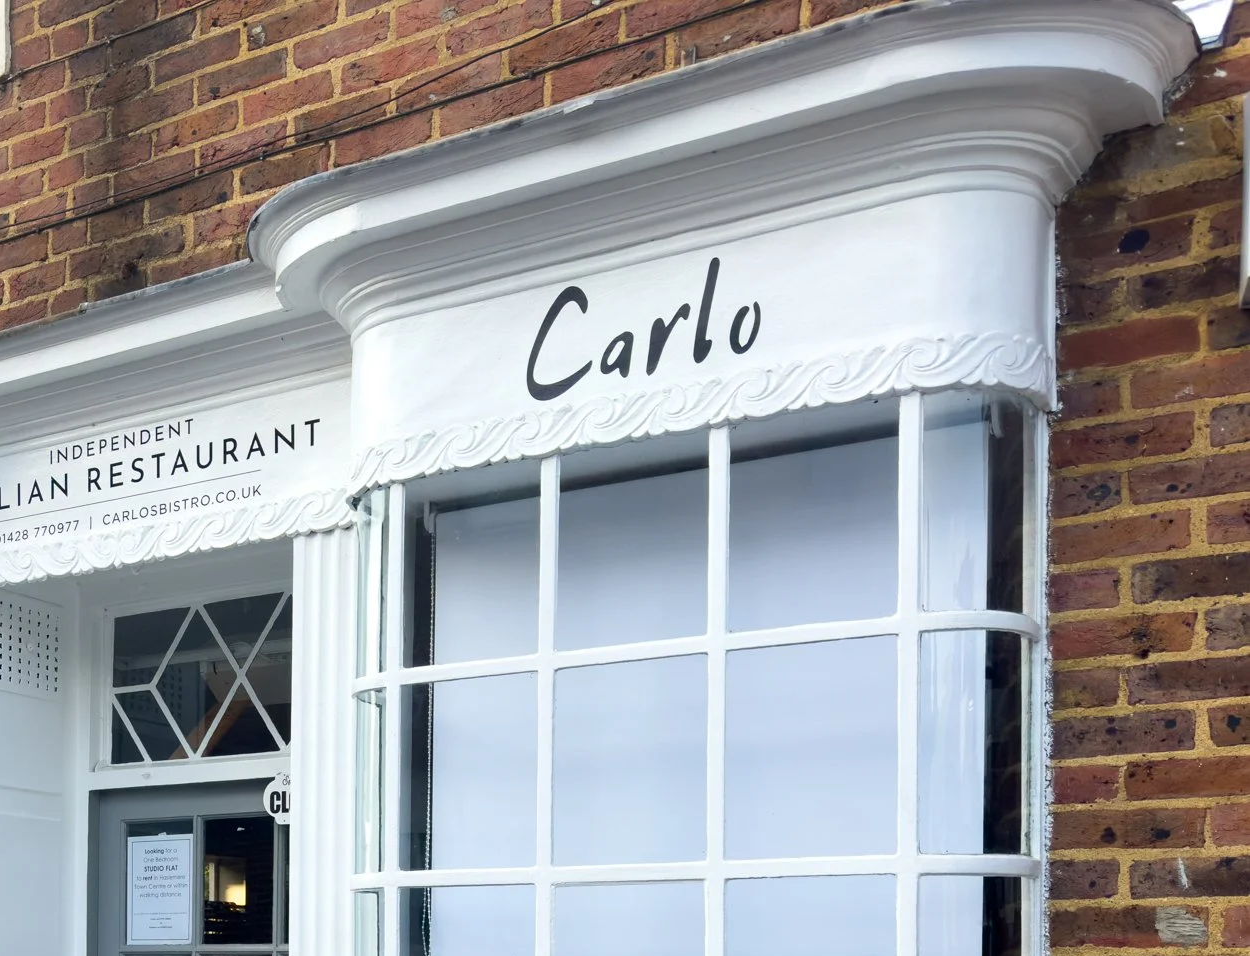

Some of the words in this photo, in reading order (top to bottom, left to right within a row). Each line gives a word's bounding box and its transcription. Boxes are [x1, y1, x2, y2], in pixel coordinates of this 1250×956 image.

[526, 257, 761, 401] Carlo
[49, 418, 194, 465] INDEPENDENT
[87, 418, 320, 492] RESTAURANT
[34, 519, 80, 538] 770977
[102, 484, 262, 526] CARLOSBISTRO.CO.UK
[270, 790, 290, 814] CL
